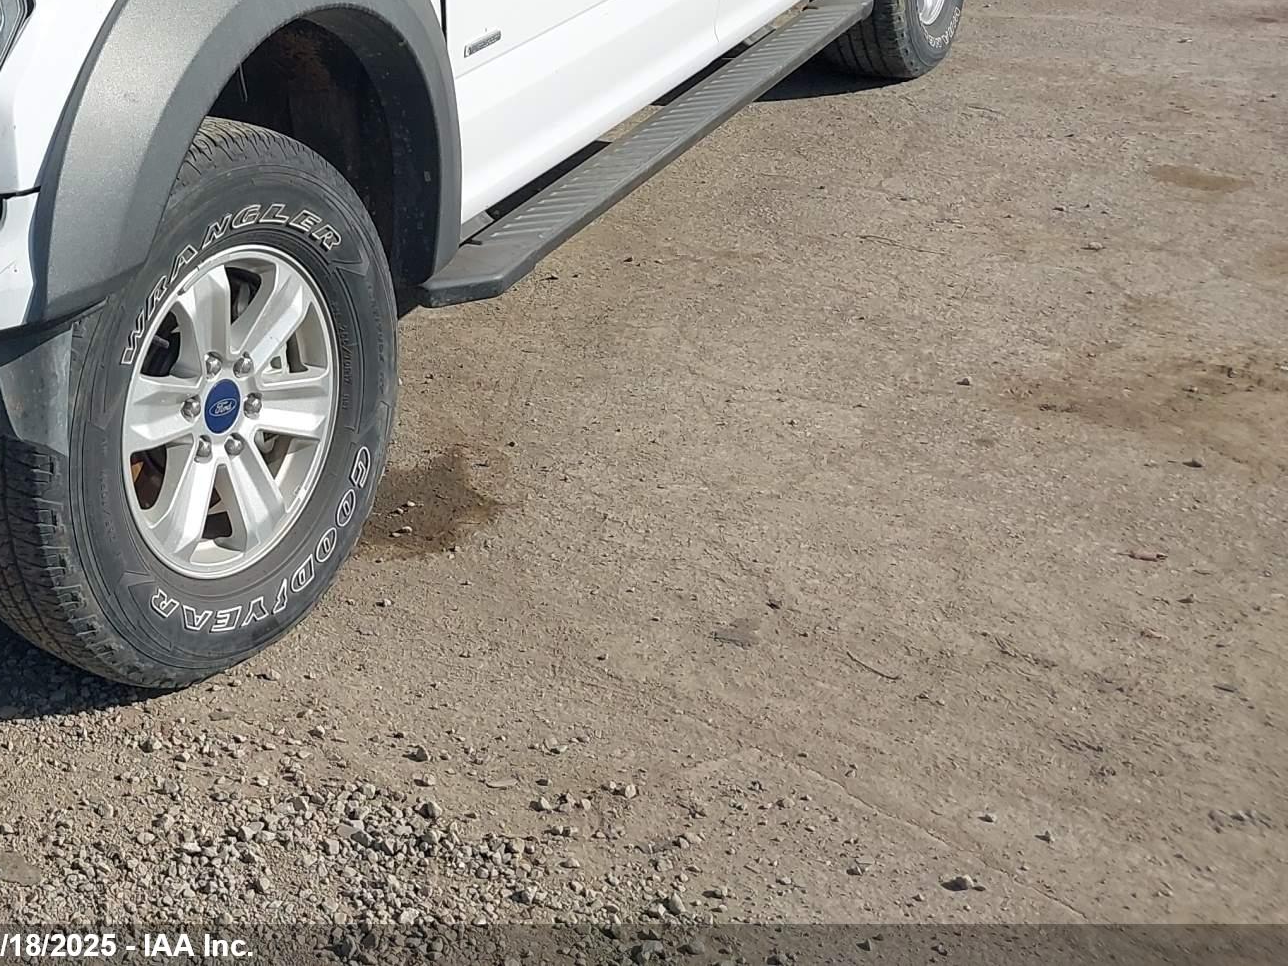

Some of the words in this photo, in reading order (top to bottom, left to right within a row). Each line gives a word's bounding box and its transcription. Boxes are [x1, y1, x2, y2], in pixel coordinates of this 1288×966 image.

[121, 203, 342, 365] WRANGLER
[213, 399, 234, 414] Ford
[150, 445, 371, 632] GOODYEAR
